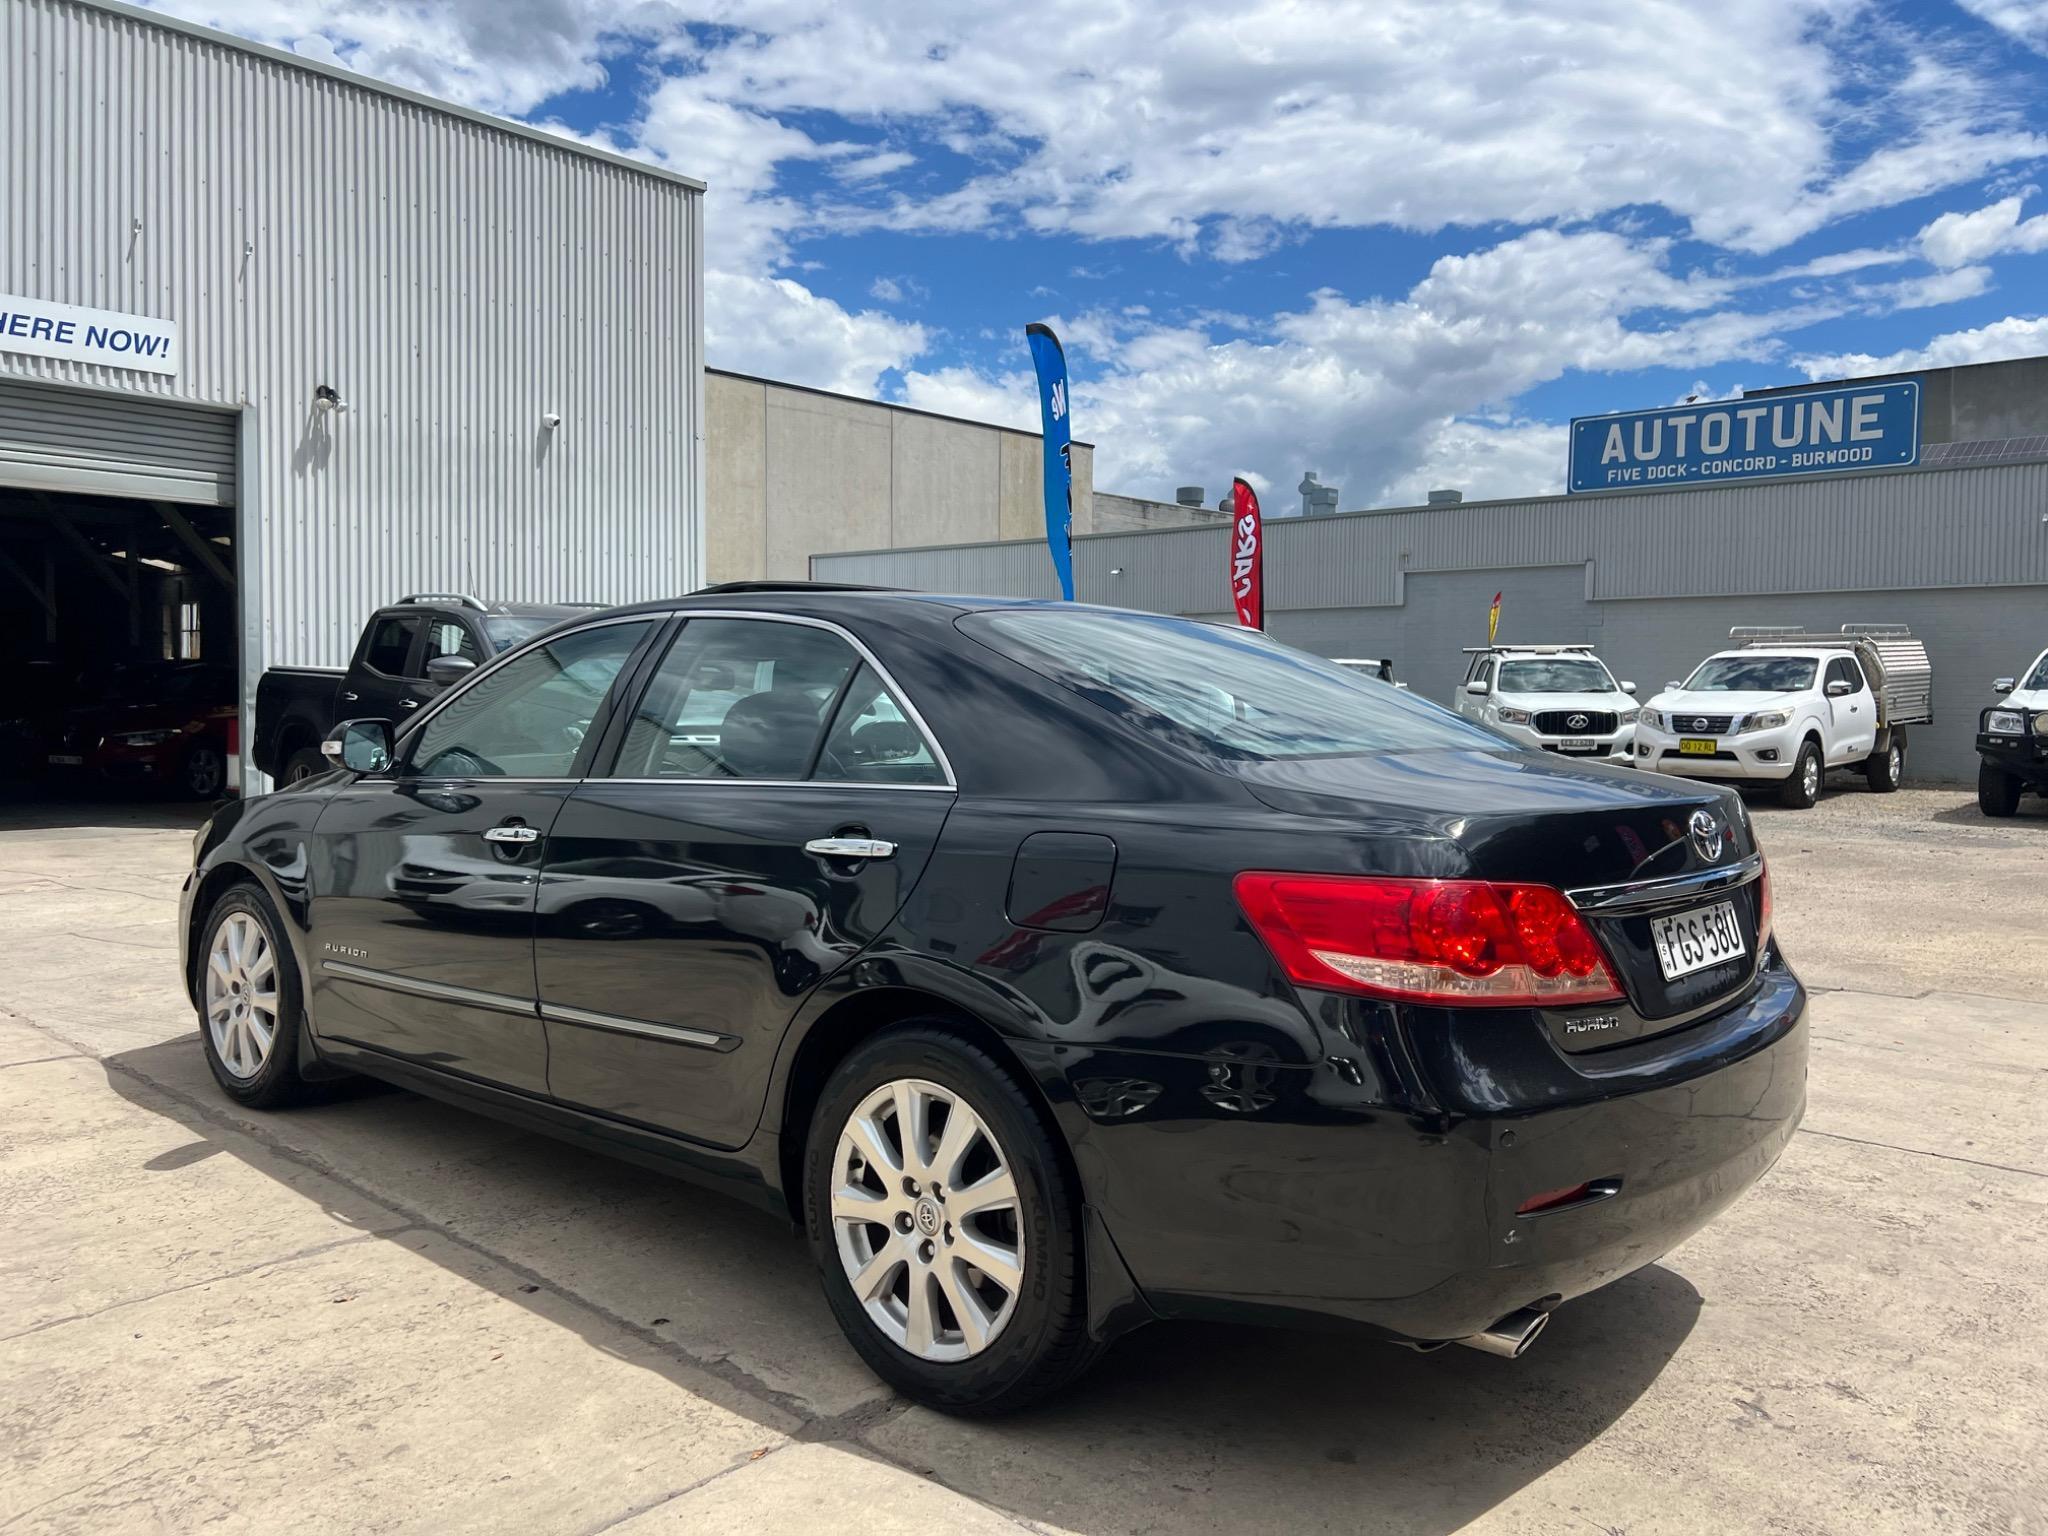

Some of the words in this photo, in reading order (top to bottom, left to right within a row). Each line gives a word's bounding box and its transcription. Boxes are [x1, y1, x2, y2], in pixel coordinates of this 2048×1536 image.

[85, 325, 170, 359] NOW!
[1601, 394, 1886, 465] AUTOTUNE
[1607, 467, 1641, 483] FIVE
[1647, 464, 1687, 480] DOCK
[1701, 456, 1777, 475] CONCORD
[1791, 447, 1873, 468] BURWOOD
[325, 943, 368, 958] AURION
